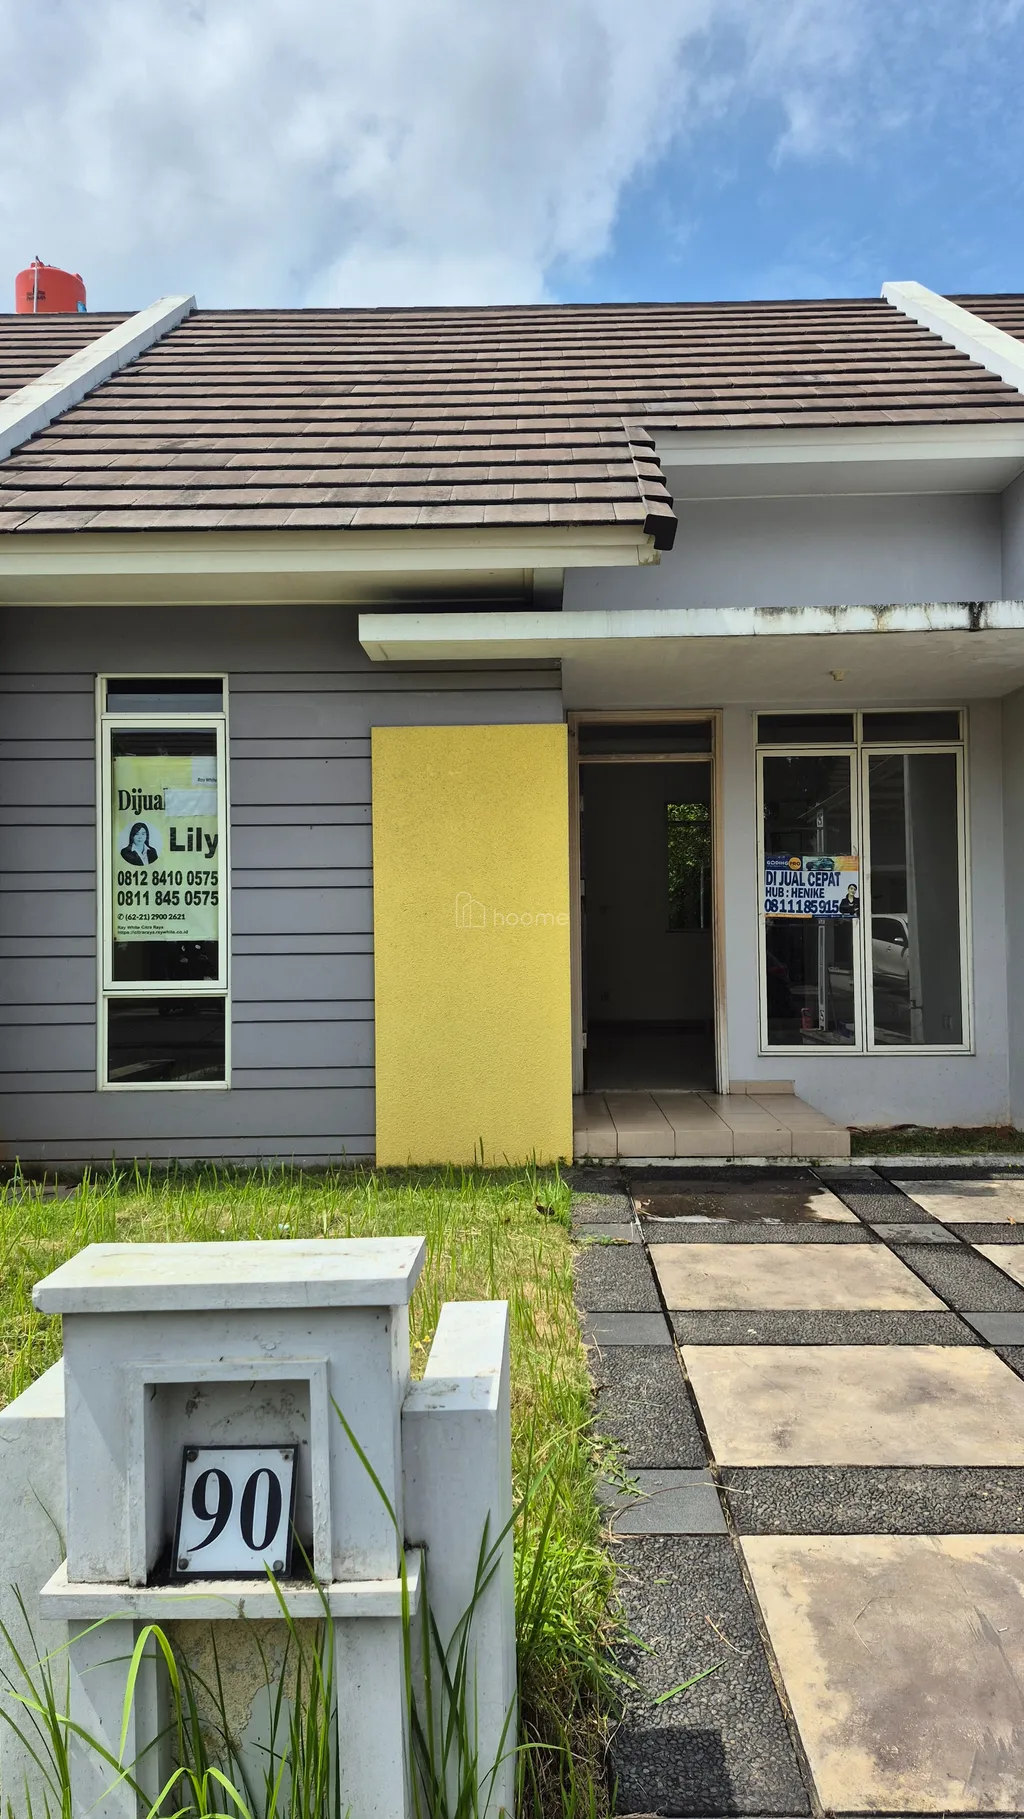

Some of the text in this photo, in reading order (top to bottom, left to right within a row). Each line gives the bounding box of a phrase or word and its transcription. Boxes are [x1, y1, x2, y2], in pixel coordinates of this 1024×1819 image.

[170, 827, 218, 858] Lily
[118, 871, 218, 886] 0812 8410 0575
[766, 871, 841, 887] DI JUAL CEPAT
[117, 891, 219, 906] 0811 845 0575
[765, 887, 784, 897] HUB
[791, 887, 825, 898] HENIKE
[125, 913, 150, 921] (62-21)
[187, 1468, 282, 1552] 90
